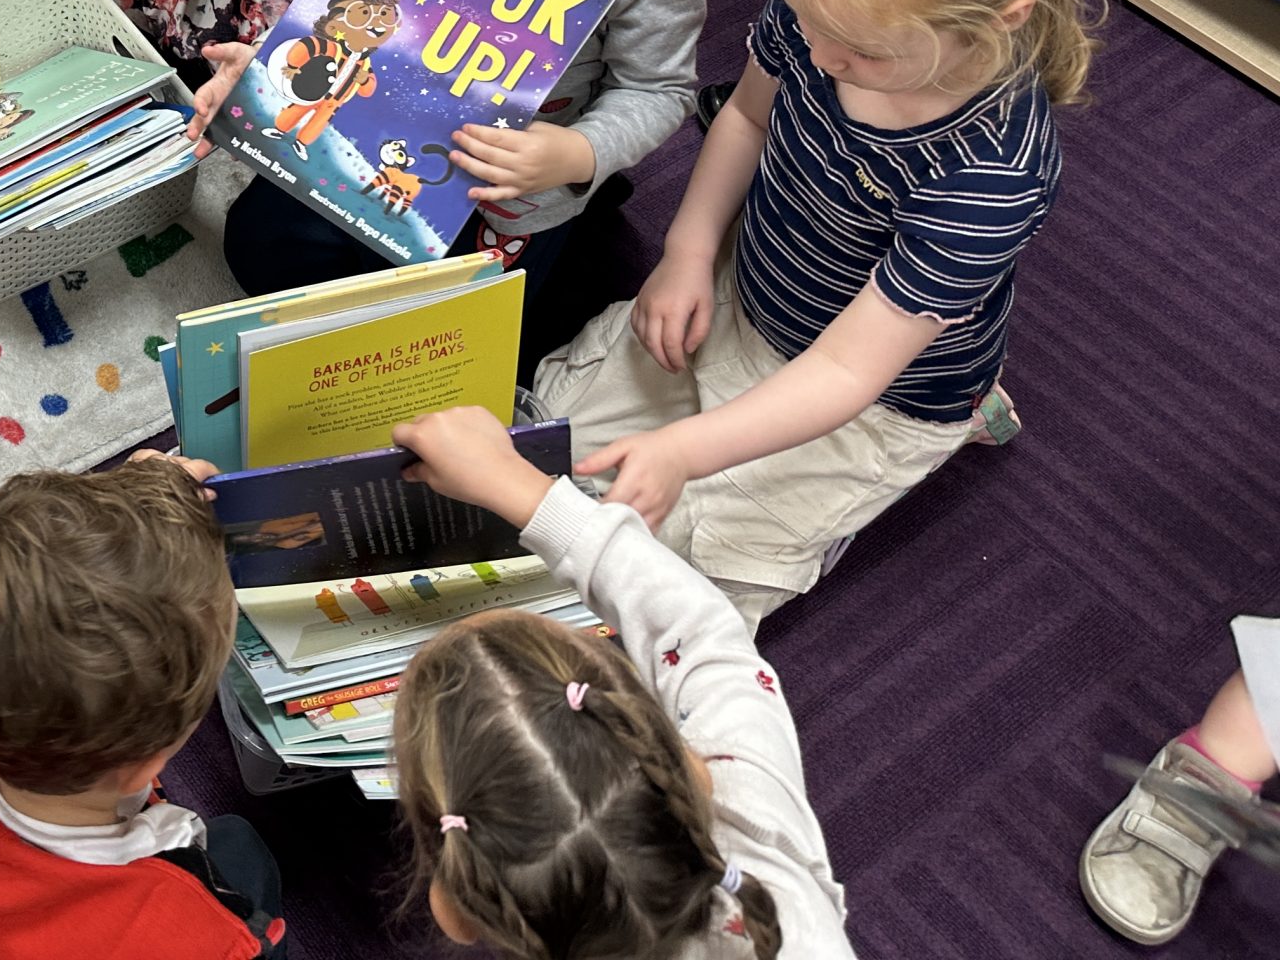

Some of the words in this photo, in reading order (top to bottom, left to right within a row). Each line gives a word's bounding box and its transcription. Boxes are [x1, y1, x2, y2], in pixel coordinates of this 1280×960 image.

[421, 10, 536, 106] UP!
[56, 85, 107, 109] name
[231, 136, 242, 148] by
[240, 141, 271, 167] Nathan
[269, 161, 297, 184] Bryon
[345, 212, 356, 224] by
[355, 218, 381, 239] Dapo
[378, 233, 412, 260] Adeola
[309, 376, 339, 392] ONE
[348, 369, 367, 383] OF
[374, 354, 421, 377] THOSE
[313, 352, 382, 378] BARBARA
[390, 345, 403, 359] IS
[409, 328, 463, 353] HAVING
[299, 694, 325, 709] GREG
[333, 687, 362, 701] SAUSAGE
[364, 682, 381, 694] ROLL
